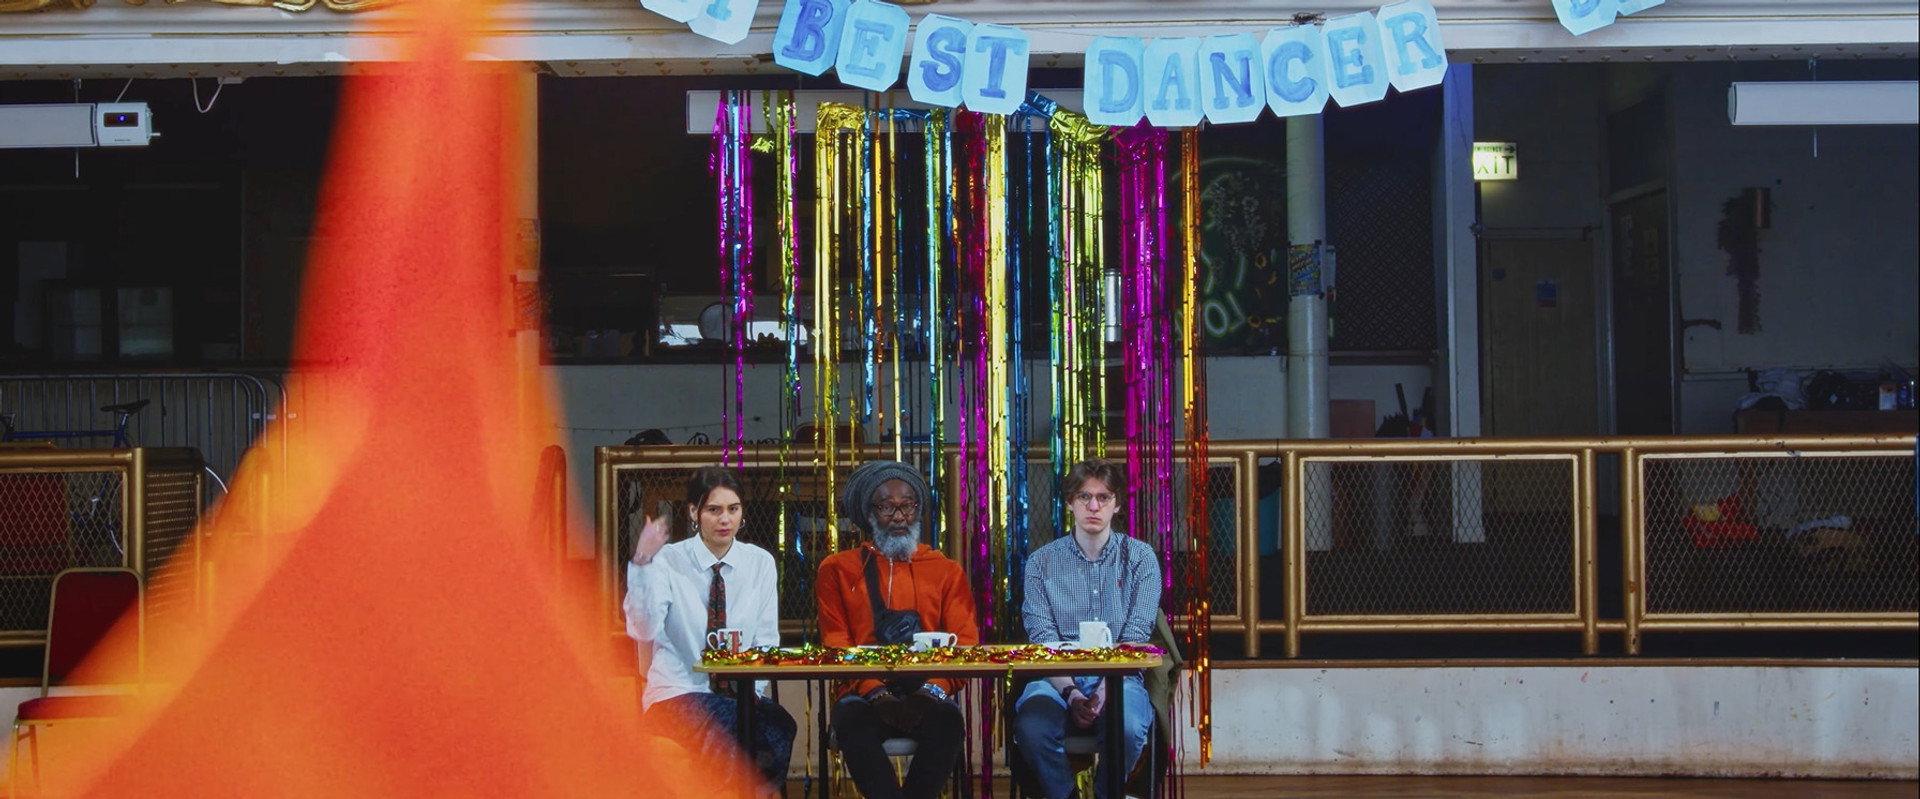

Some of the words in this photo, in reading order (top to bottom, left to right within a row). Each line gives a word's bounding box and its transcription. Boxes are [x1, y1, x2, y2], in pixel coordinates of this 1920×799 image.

[781, 0, 1027, 99] BEST
[1098, 11, 1443, 114] DANCER
[1475, 155, 1515, 175] XIT
